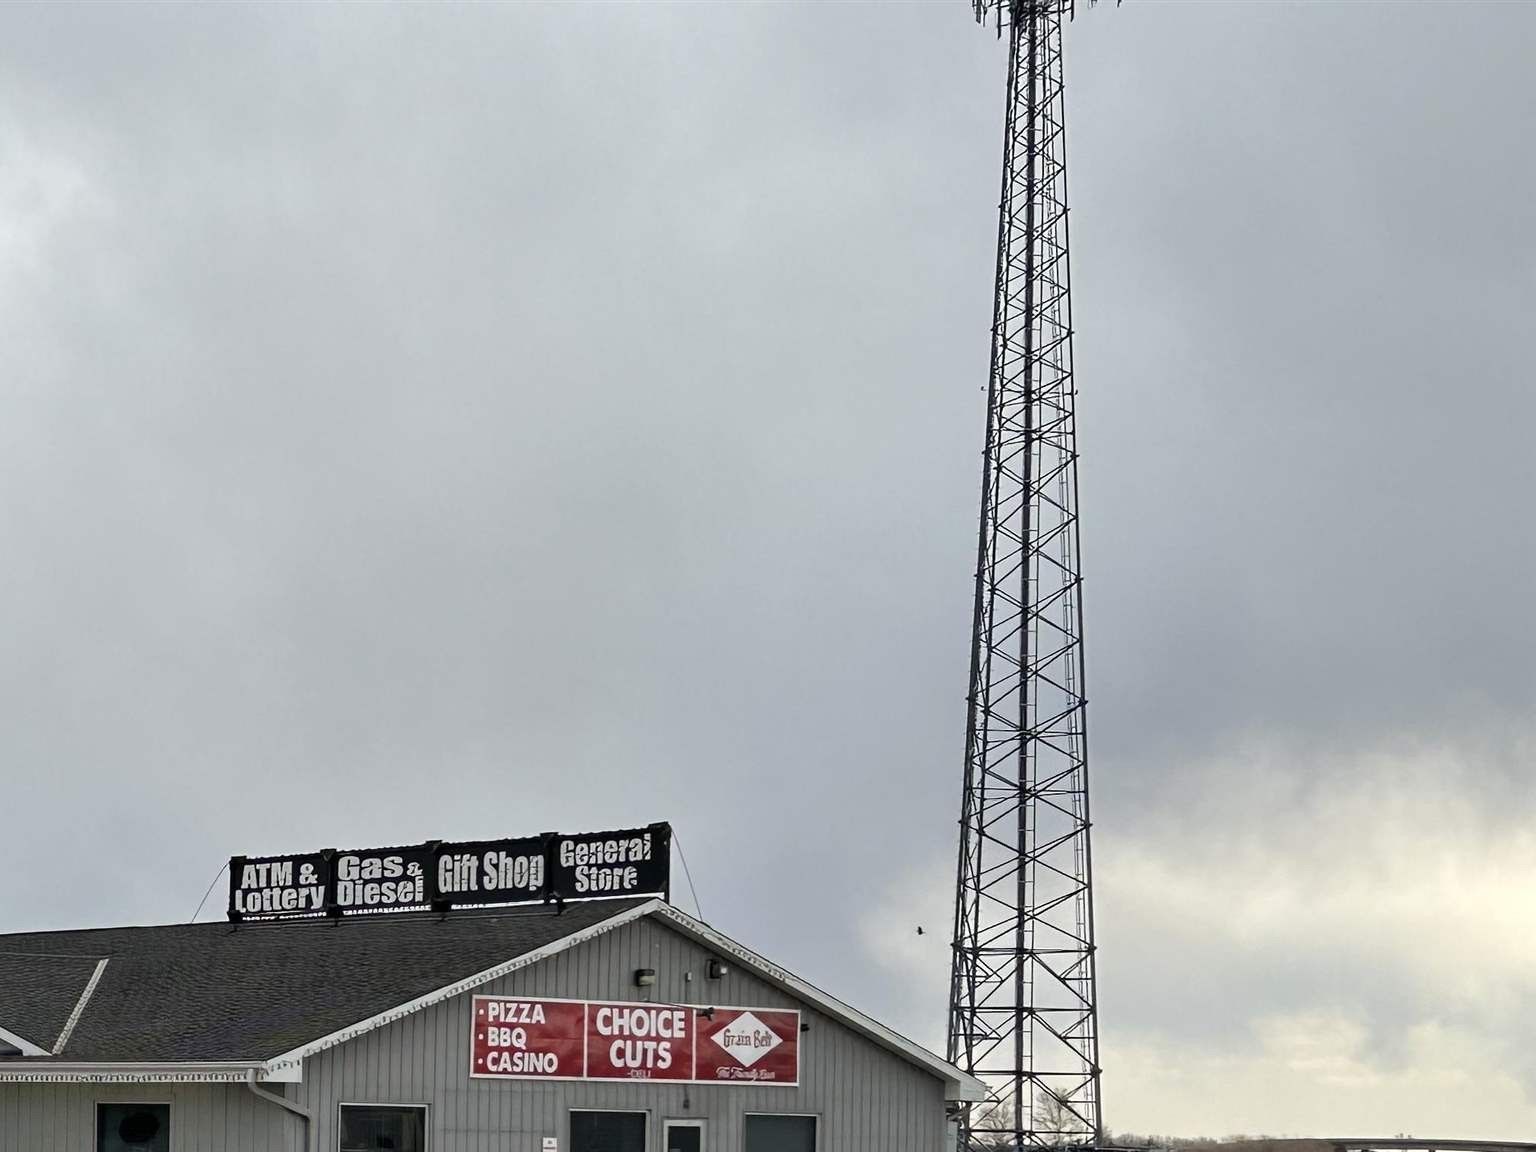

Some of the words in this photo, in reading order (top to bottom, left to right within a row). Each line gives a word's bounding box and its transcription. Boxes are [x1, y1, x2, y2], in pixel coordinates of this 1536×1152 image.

[560, 833, 652, 868] General
[241, 861, 294, 889] ATM
[299, 863, 319, 885] &
[337, 855, 404, 881] Gas
[407, 862, 424, 877] &
[438, 854, 479, 894] Gift
[483, 851, 545, 891] Shop
[575, 865, 638, 893] Store
[235, 885, 327, 914] Lottery
[337, 875, 425, 906] Diesel
[487, 1001, 546, 1025] PIZZA
[596, 1007, 686, 1039] CHOICE
[487, 1026, 527, 1051] BBQ
[486, 1051, 559, 1074] CASINO
[609, 1038, 673, 1070] CUTS
